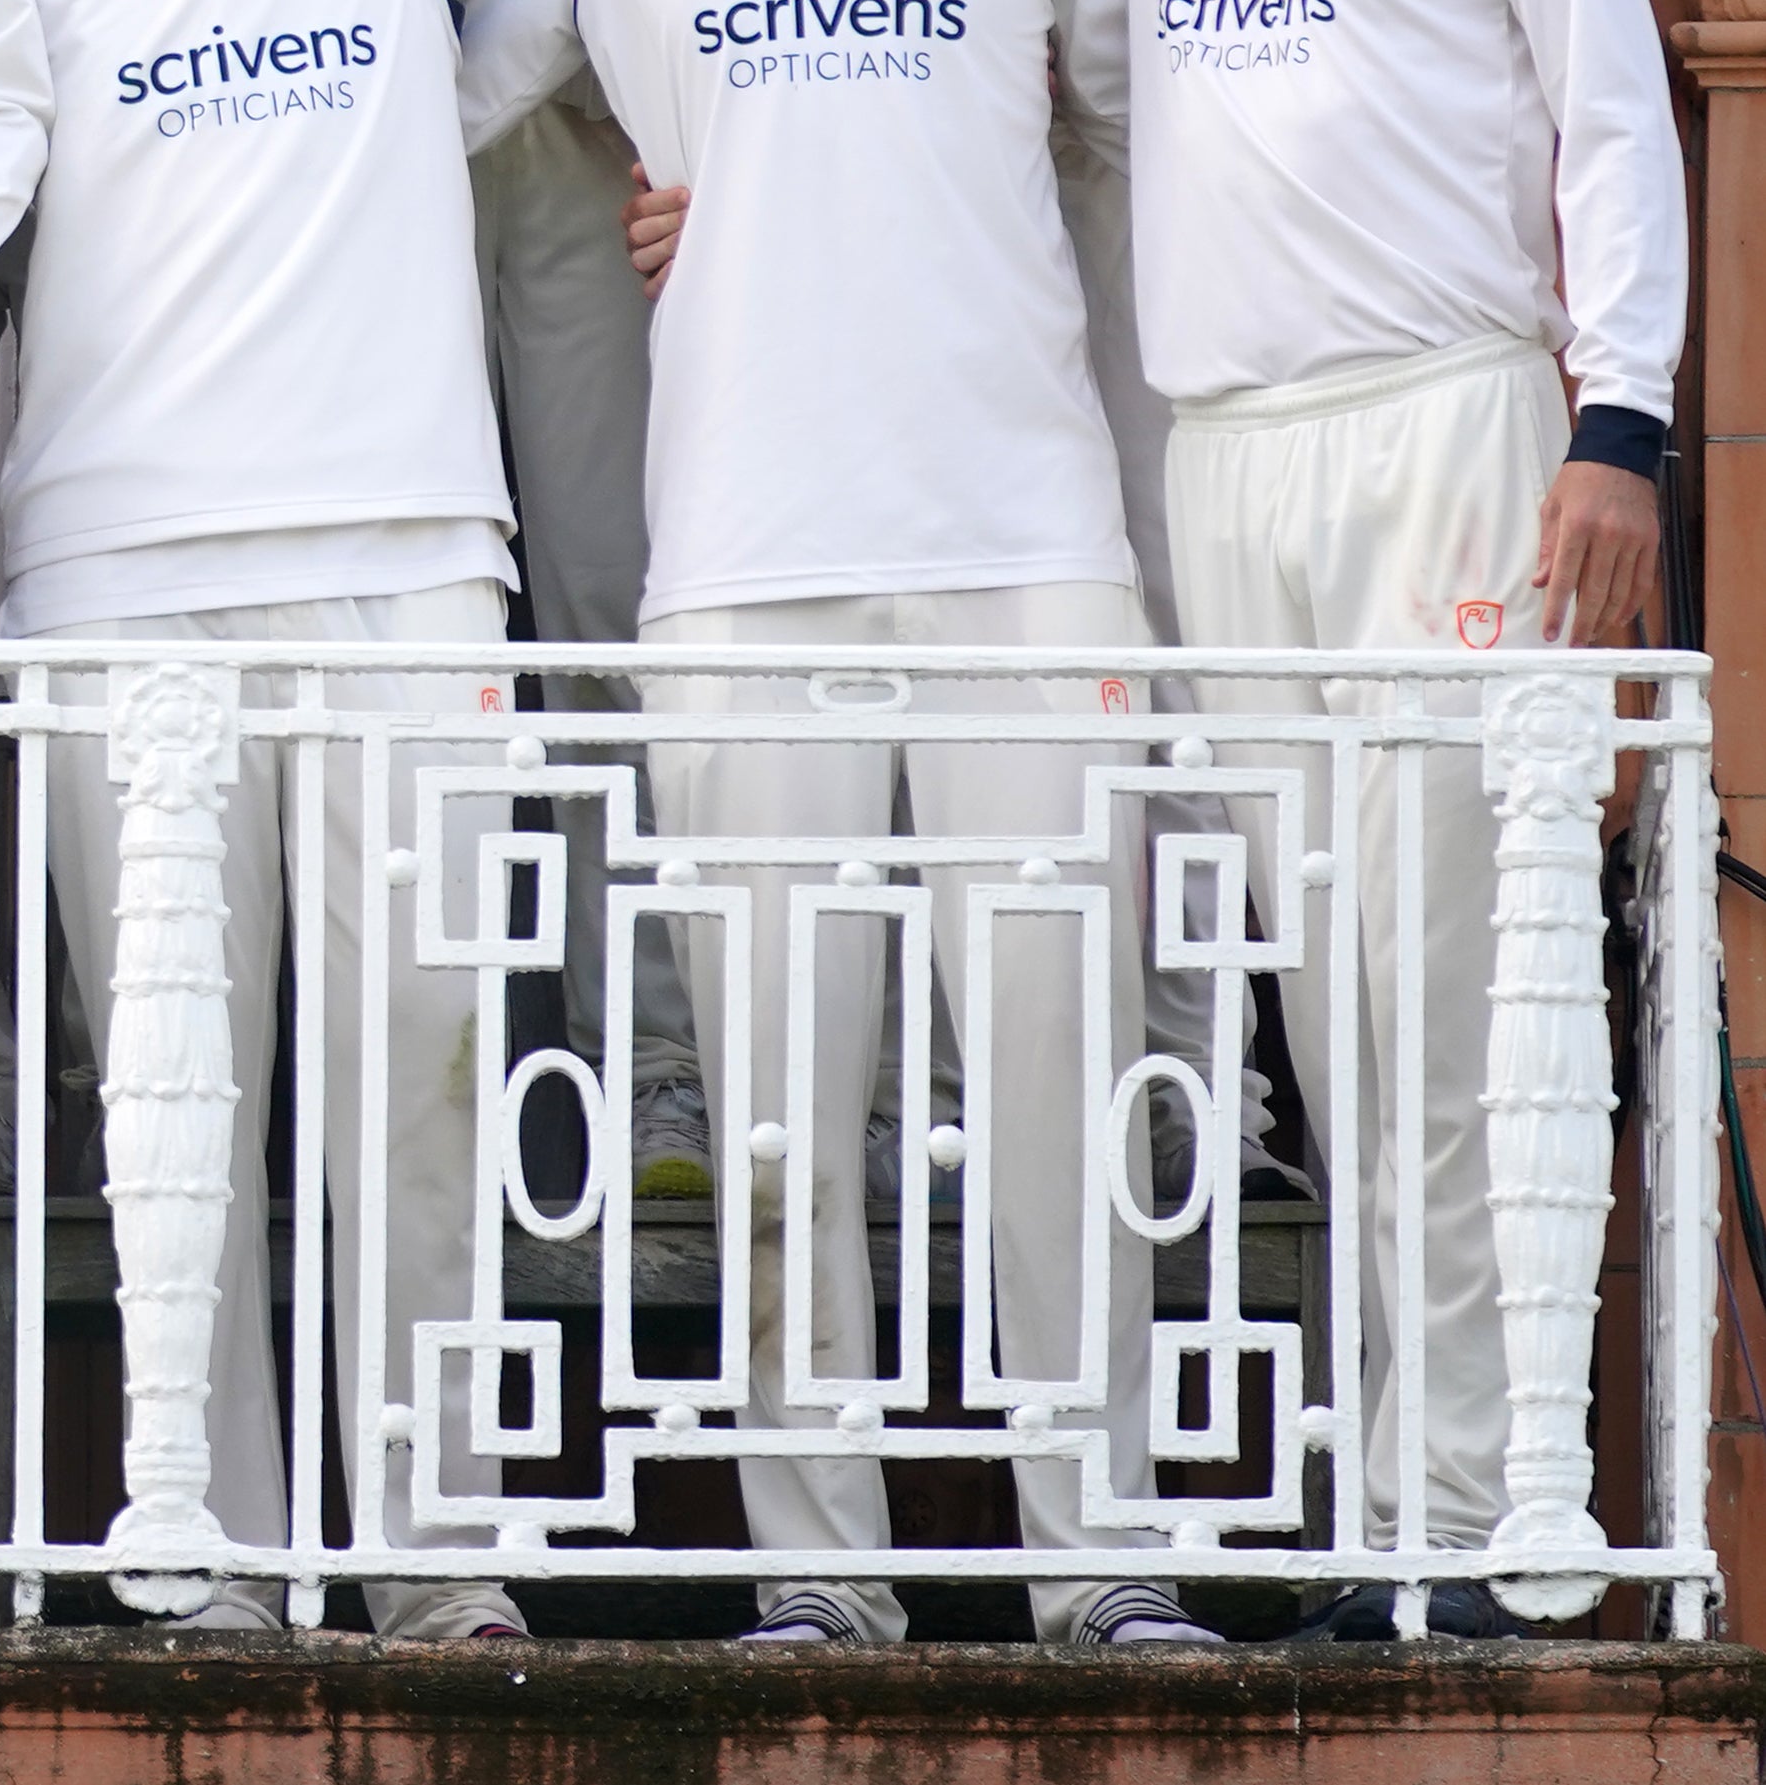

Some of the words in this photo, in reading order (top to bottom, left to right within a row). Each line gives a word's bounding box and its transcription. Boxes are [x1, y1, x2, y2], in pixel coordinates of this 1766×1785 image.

[117, 23, 376, 105] scrivens
[728, 51, 931, 89] OPTICIANS
[1169, 37, 1310, 74] OPTICIANS
[157, 81, 355, 138] OPTICIANS
[1465, 609, 1488, 623] PL
